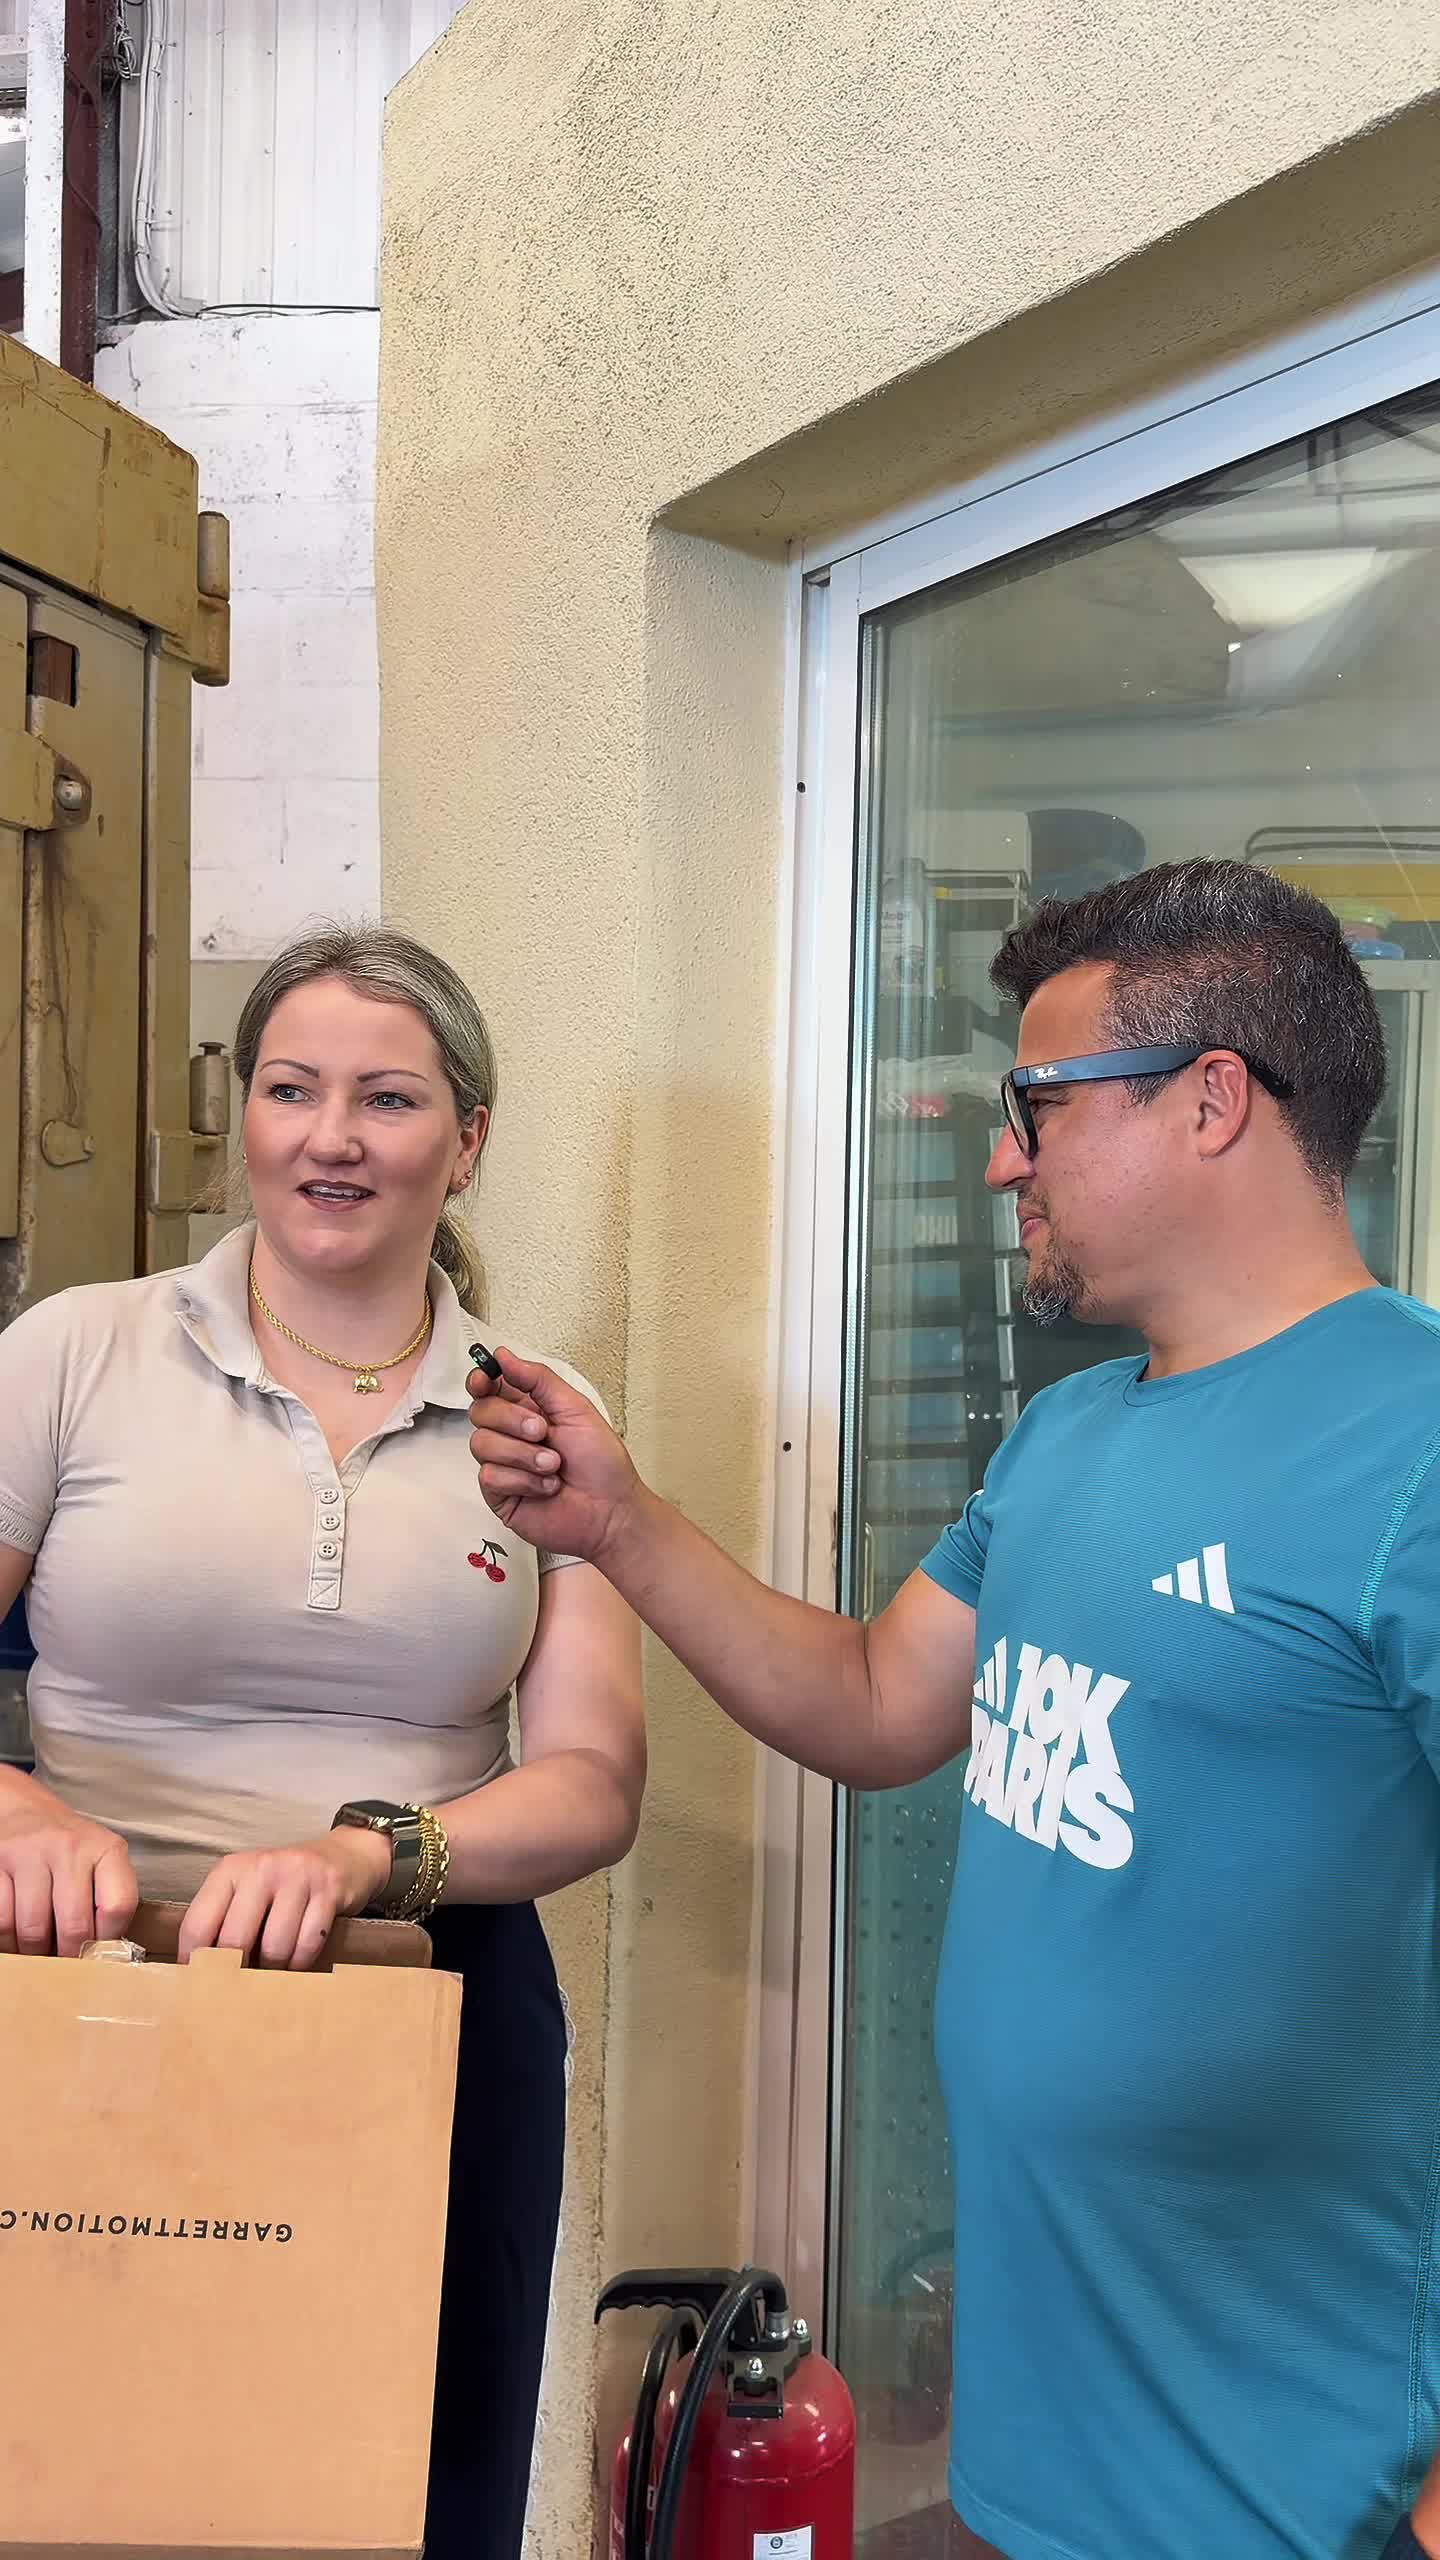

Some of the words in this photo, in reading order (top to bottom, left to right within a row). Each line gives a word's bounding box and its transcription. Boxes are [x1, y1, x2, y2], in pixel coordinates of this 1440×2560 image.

[1008, 1642, 1131, 1776] 10K
[964, 1703, 1134, 1870] PARIS
[0, 2210, 292, 2243] GARRETTMOTION.C
